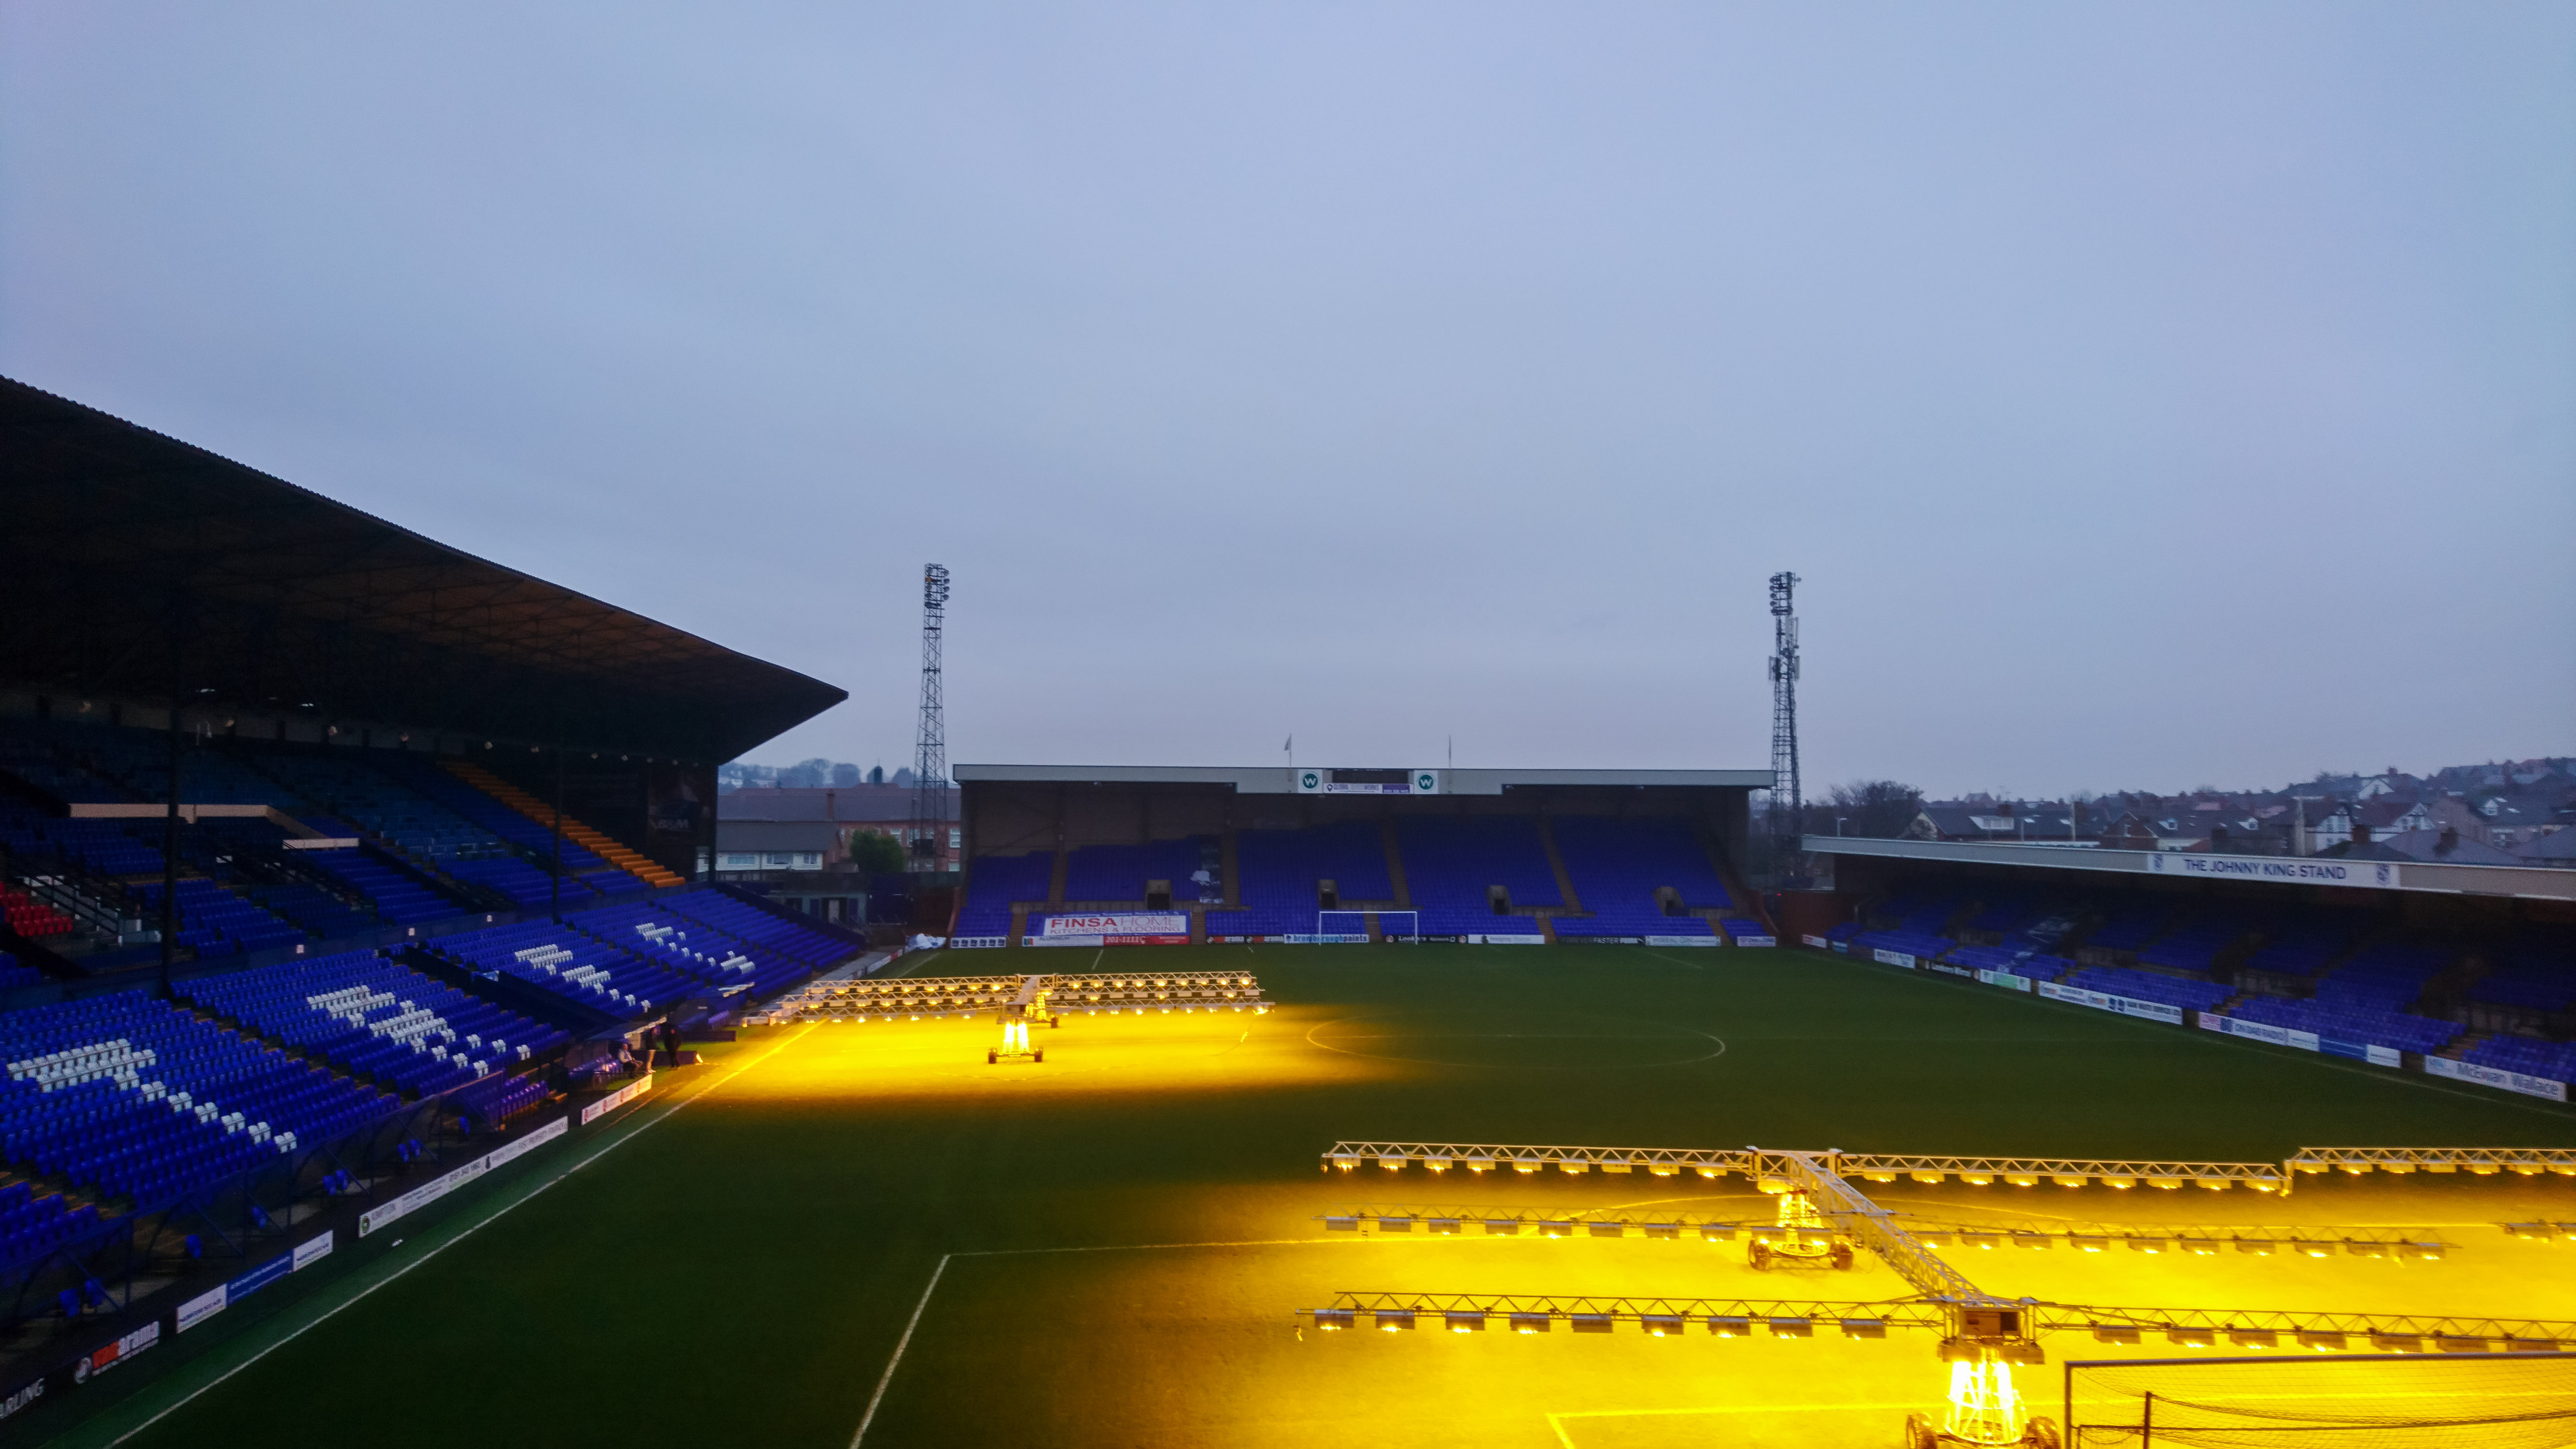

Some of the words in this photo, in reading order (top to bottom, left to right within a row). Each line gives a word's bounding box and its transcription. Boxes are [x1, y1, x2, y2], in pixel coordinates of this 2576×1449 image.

[2183, 859, 2206, 872] THE
[2210, 860, 2261, 875] JOHNNY
[2263, 862, 2295, 877] KING
[2299, 864, 2347, 880] STAND
[1051, 917, 1117, 928] FINSA
[1120, 916, 1180, 926] HOME
